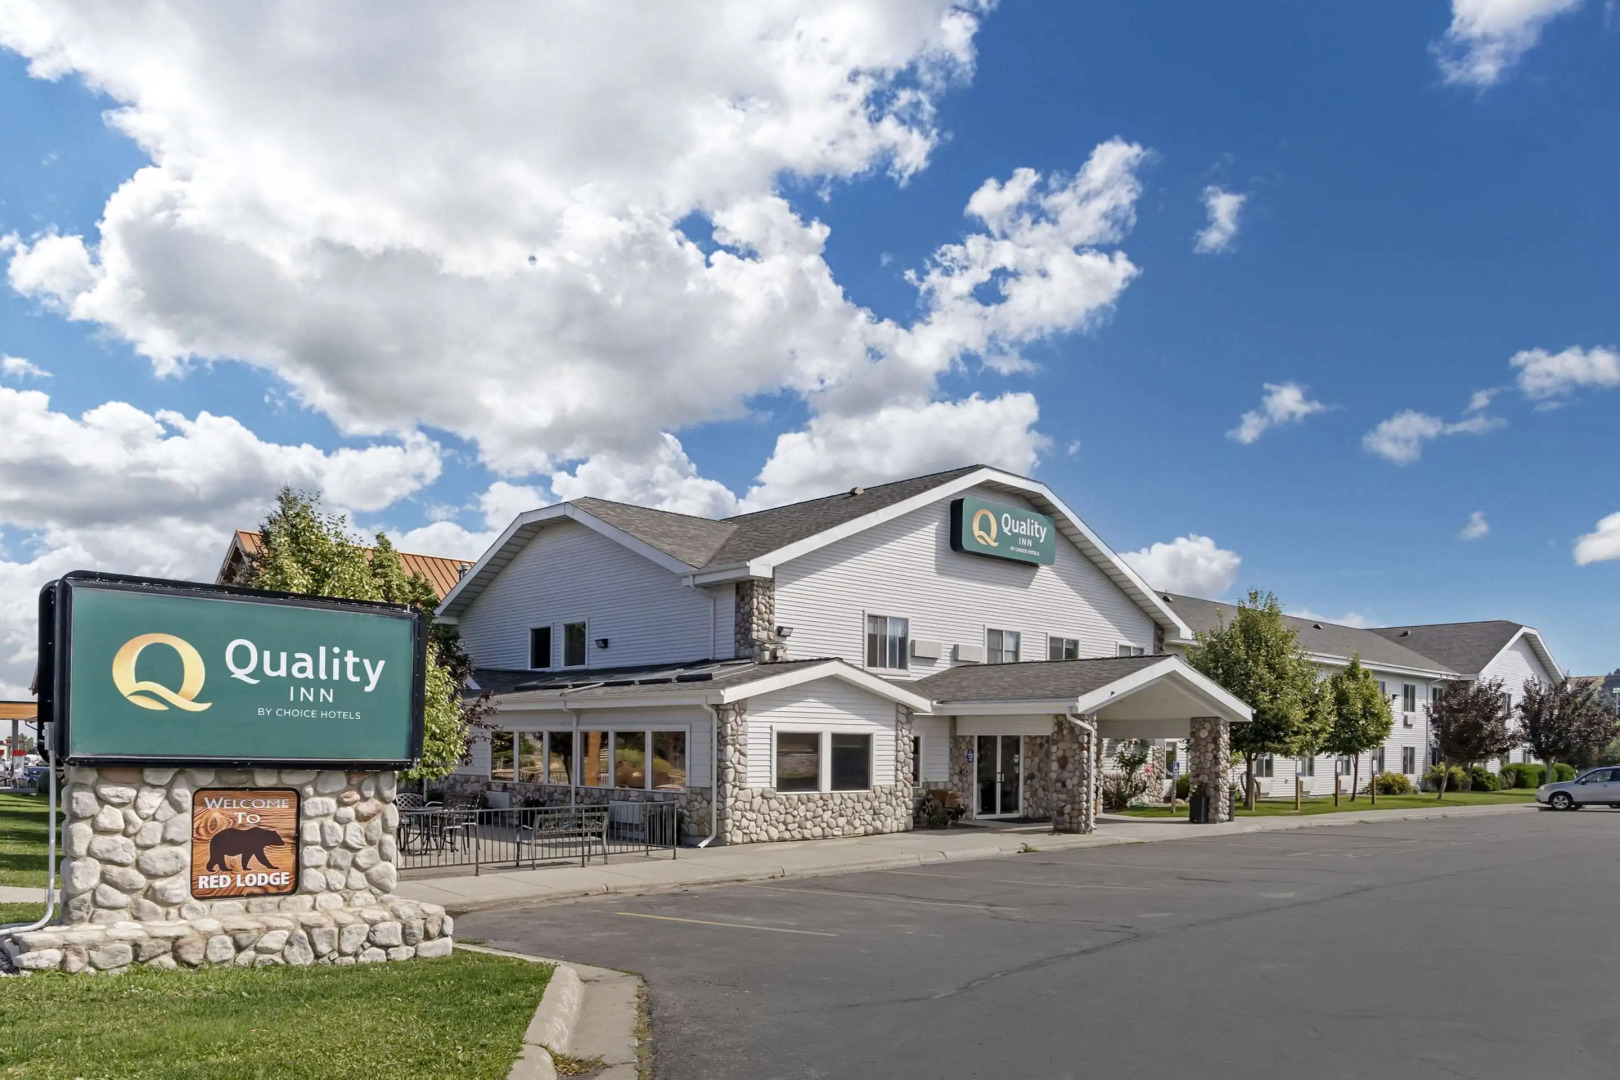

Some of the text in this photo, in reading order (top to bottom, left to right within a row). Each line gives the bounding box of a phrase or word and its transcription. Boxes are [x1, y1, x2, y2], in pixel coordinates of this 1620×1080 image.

[972, 508, 999, 547] Q
[1001, 513, 1047, 543] Quality
[1018, 537, 1033, 547] INN
[112, 632, 213, 712] Q
[225, 638, 386, 692] Quality
[289, 686, 334, 703] INN
[257, 707, 361, 720] BY CHOICE HOTELS
[204, 797, 289, 809] WELCOME
[234, 811, 261, 824] TO
[198, 872, 290, 889] RED LODGE
